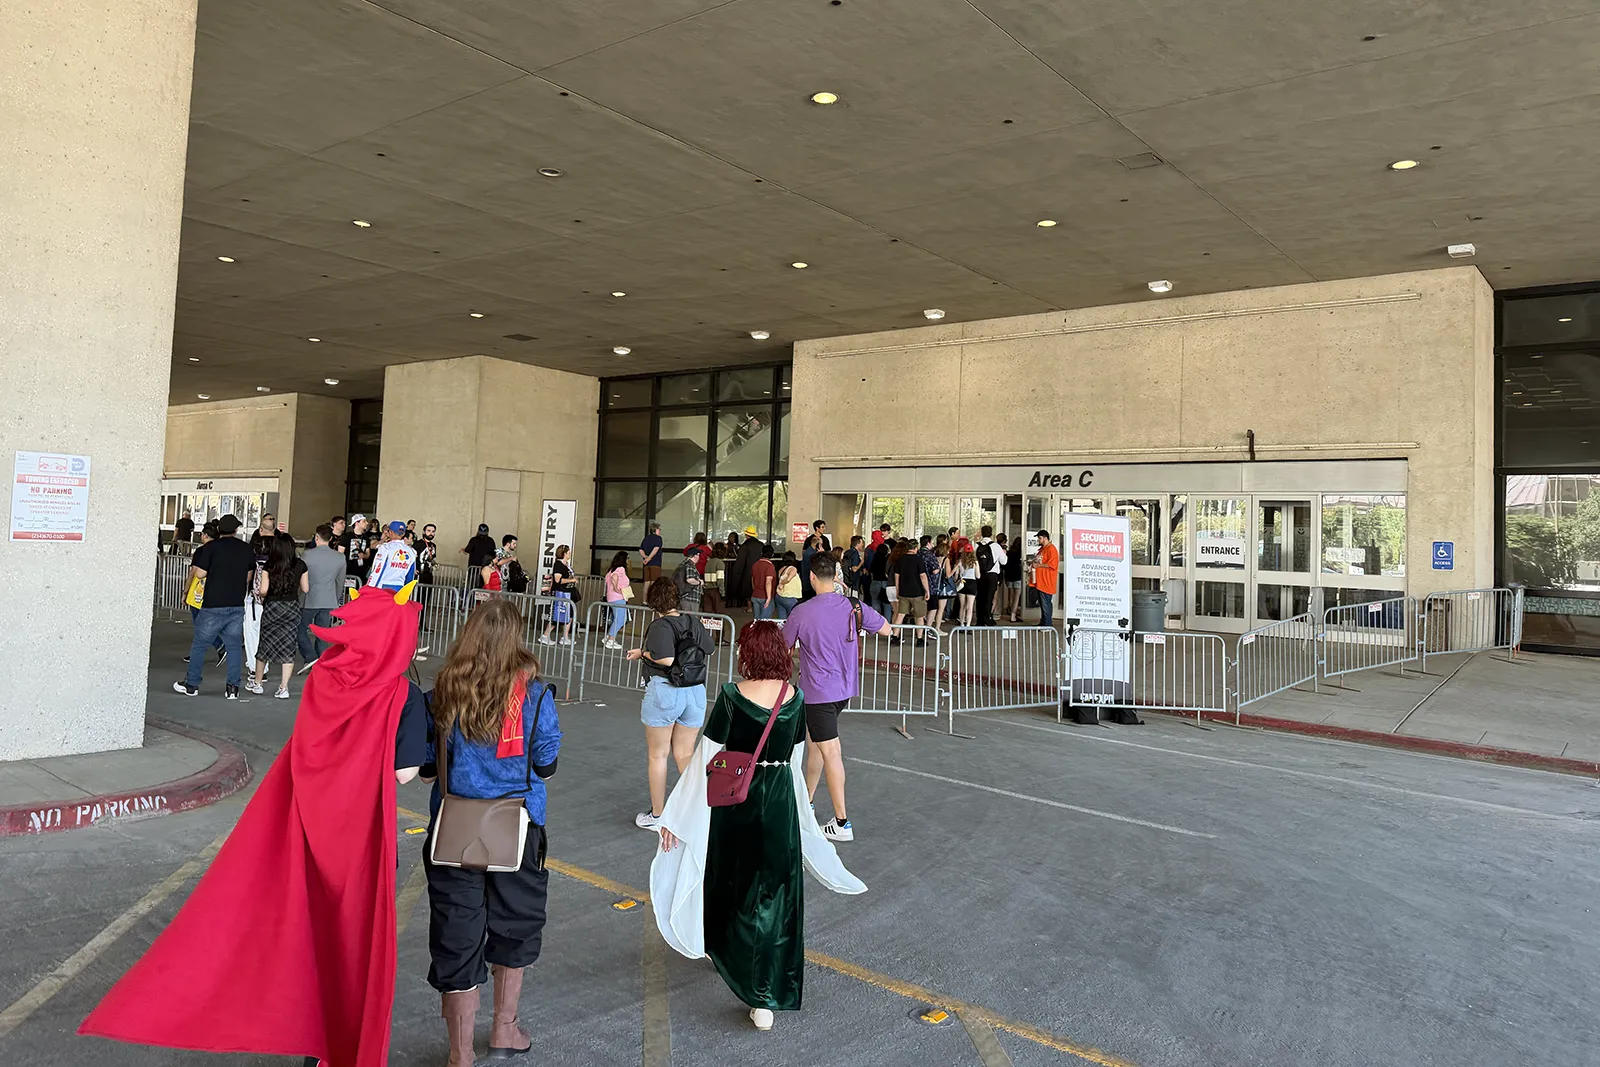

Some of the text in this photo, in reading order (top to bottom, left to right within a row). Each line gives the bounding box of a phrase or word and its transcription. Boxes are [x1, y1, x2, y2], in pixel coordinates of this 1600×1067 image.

[1028, 470, 1094, 488] Area C
[1080, 533, 1116, 543] SECURITY
[1075, 542, 1121, 553] CHECK POINT
[1201, 546, 1240, 555] ENTRANCE
[1076, 576, 1118, 585] TECHNOLOGY
[28, 795, 168, 835] NO PARKING
